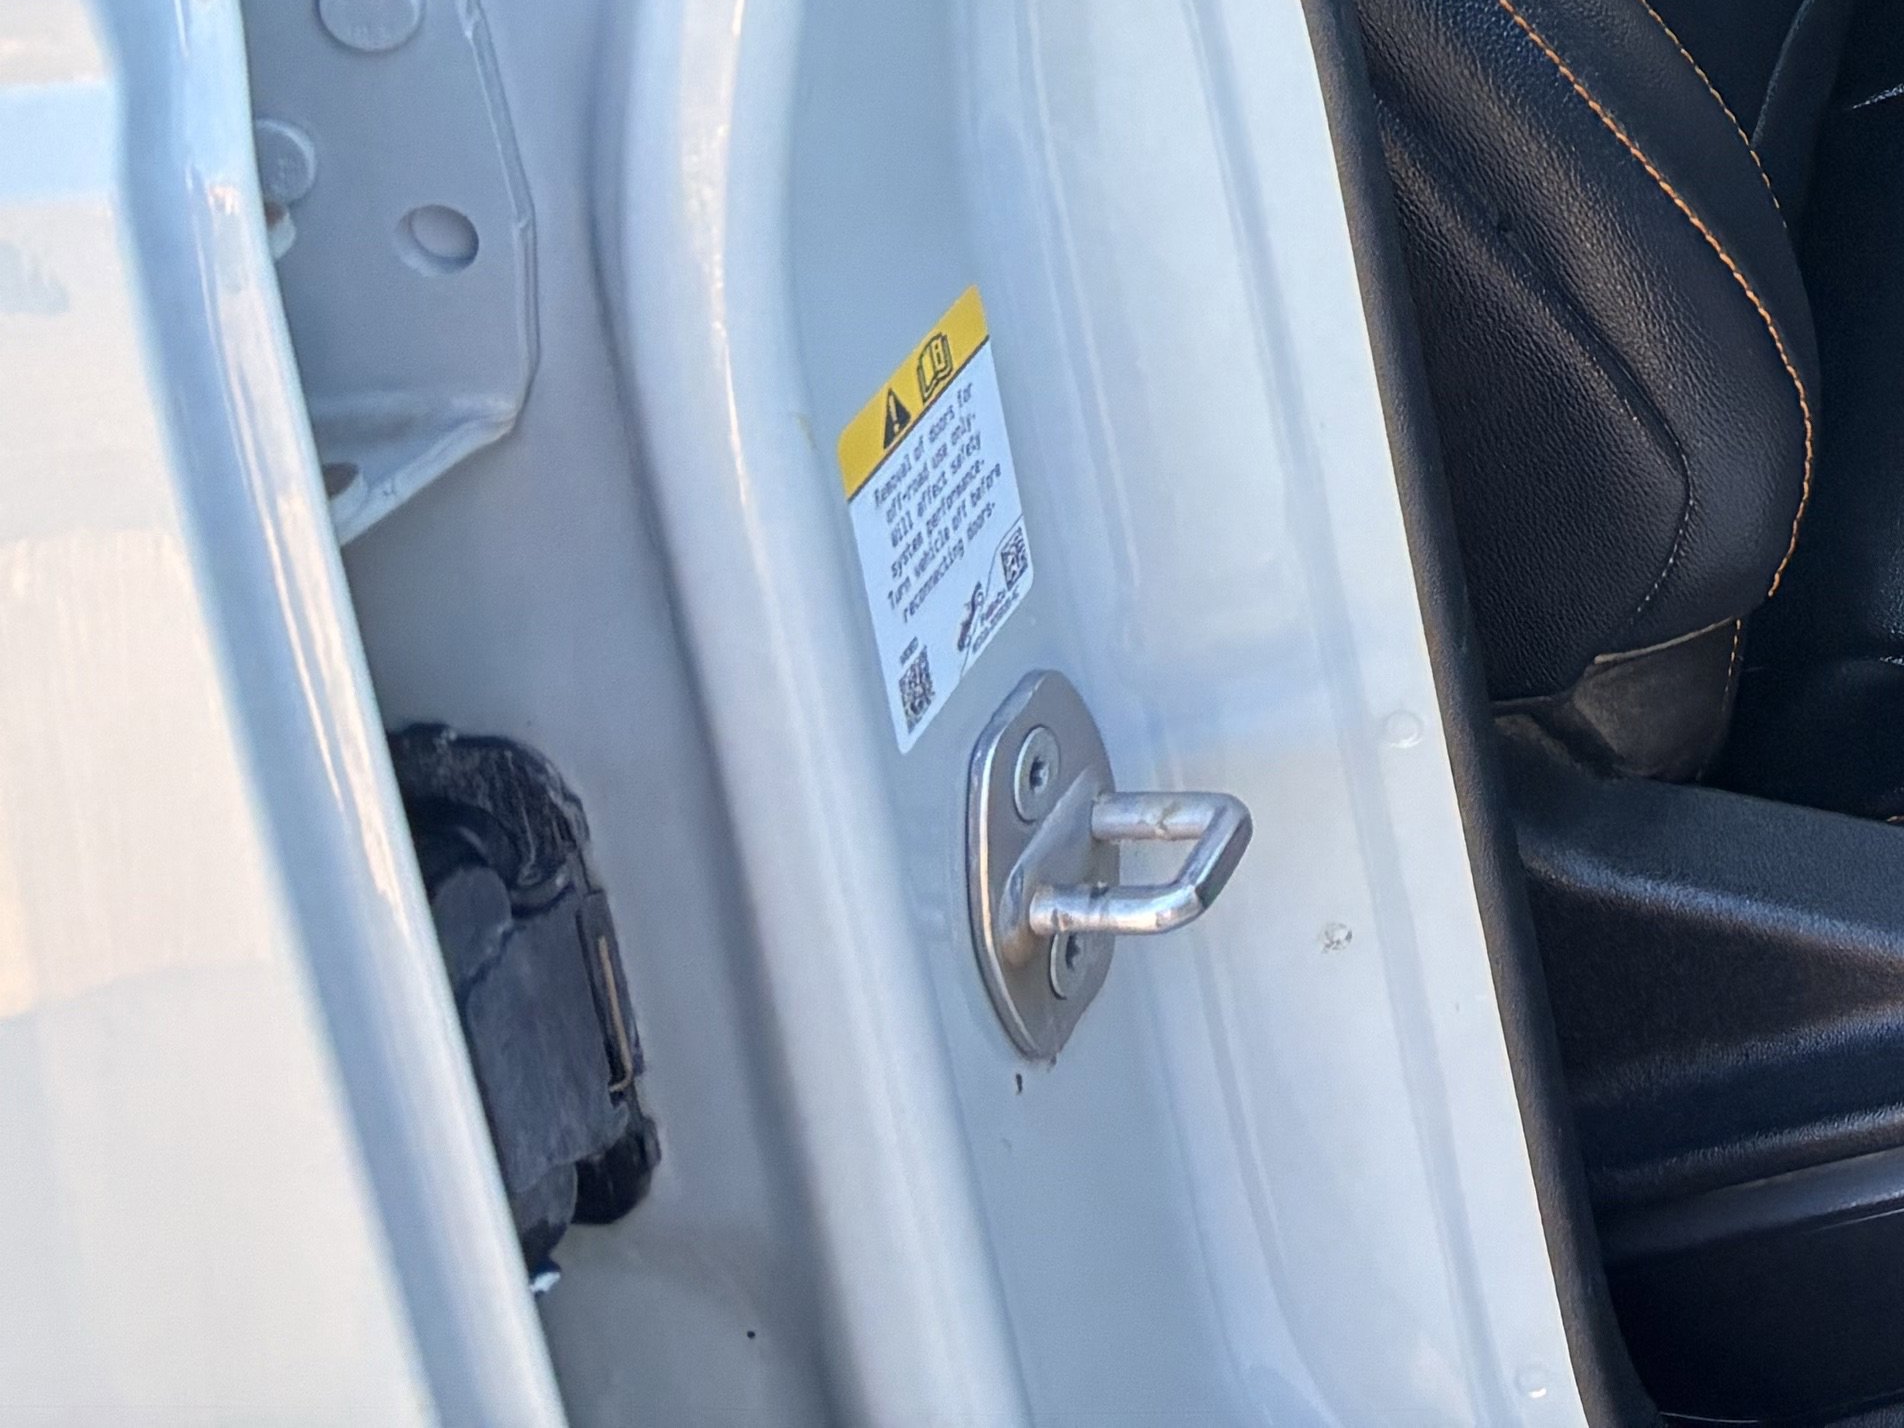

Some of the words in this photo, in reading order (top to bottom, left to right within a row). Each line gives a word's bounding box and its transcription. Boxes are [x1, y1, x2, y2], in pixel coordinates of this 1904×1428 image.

[873, 453, 912, 510] Removal
[913, 434, 924, 462] of
[928, 404, 955, 442] doors
[956, 381, 973, 408] for
[885, 460, 929, 525] off-road
[931, 442, 948, 469] use
[916, 469, 947, 518] affect
[949, 430, 981, 475] safety
[886, 575, 911, 610] Turn
[913, 525, 950, 579] vehicle
[951, 498, 967, 532] off
[969, 462, 1001, 507] before
[890, 534, 922, 578] system
[902, 537, 964, 623] reconnecting
